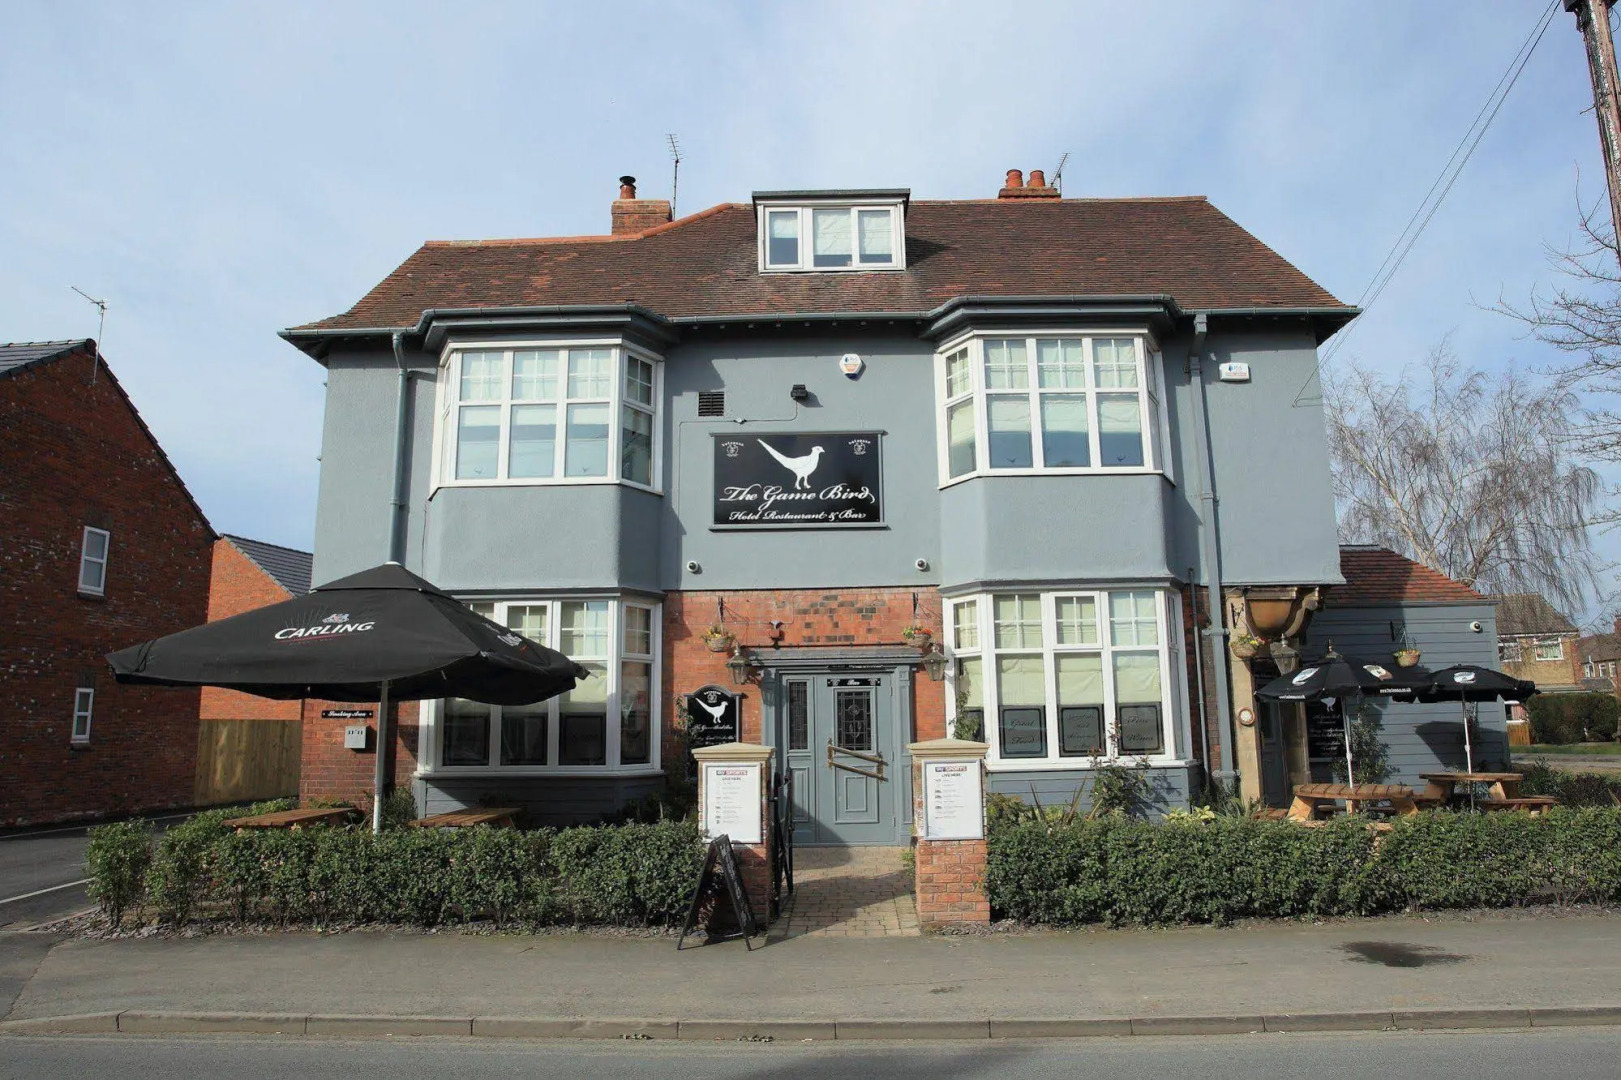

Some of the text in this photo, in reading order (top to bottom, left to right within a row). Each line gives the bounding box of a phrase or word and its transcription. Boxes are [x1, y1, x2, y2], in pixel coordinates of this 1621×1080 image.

[719, 483, 875, 511] The Game Bird
[729, 508, 866, 522] Hotel Restaurant & Bar
[274, 621, 376, 640] CARLING
[1008, 718, 1036, 731] Great
[1011, 735, 1036, 744] Food
